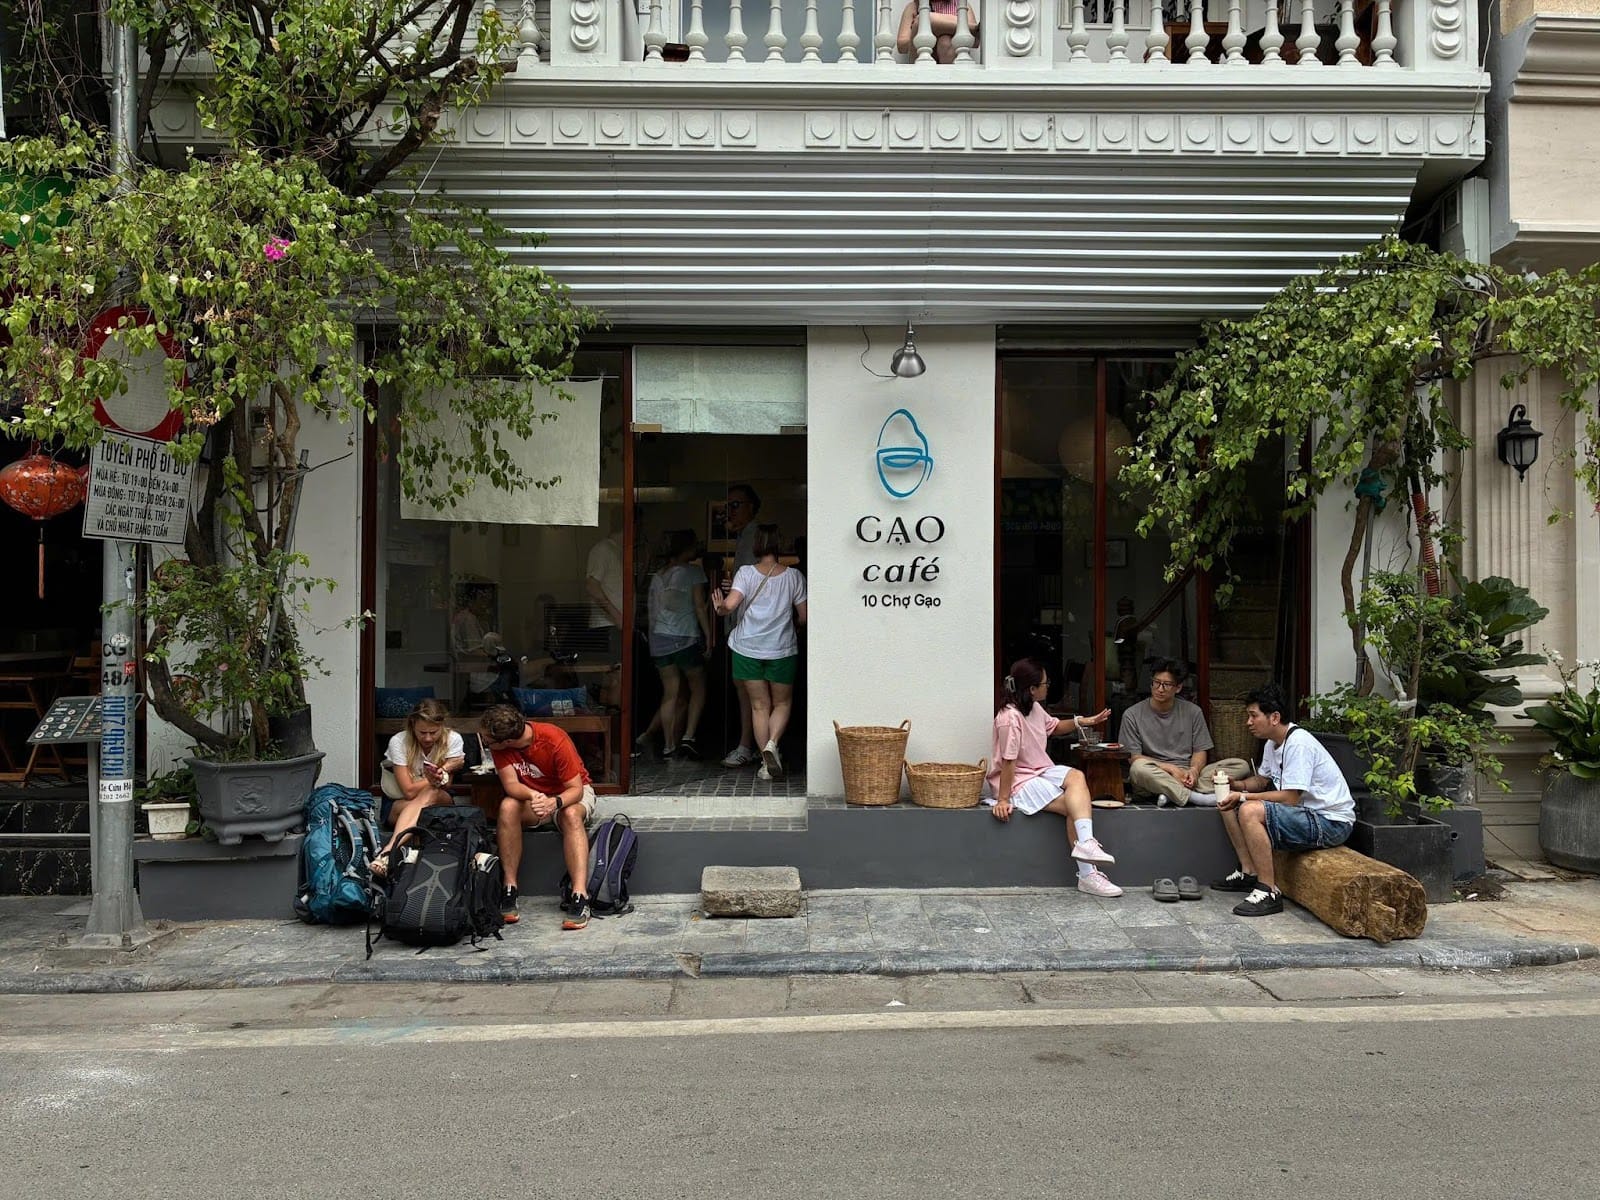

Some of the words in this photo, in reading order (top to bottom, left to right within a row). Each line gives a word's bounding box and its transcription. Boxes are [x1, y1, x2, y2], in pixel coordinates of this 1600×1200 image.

[862, 556, 940, 583] café
[862, 594, 877, 607] 10
[881, 594, 911, 609] Chợ
[914, 594, 941, 608] Gạo
